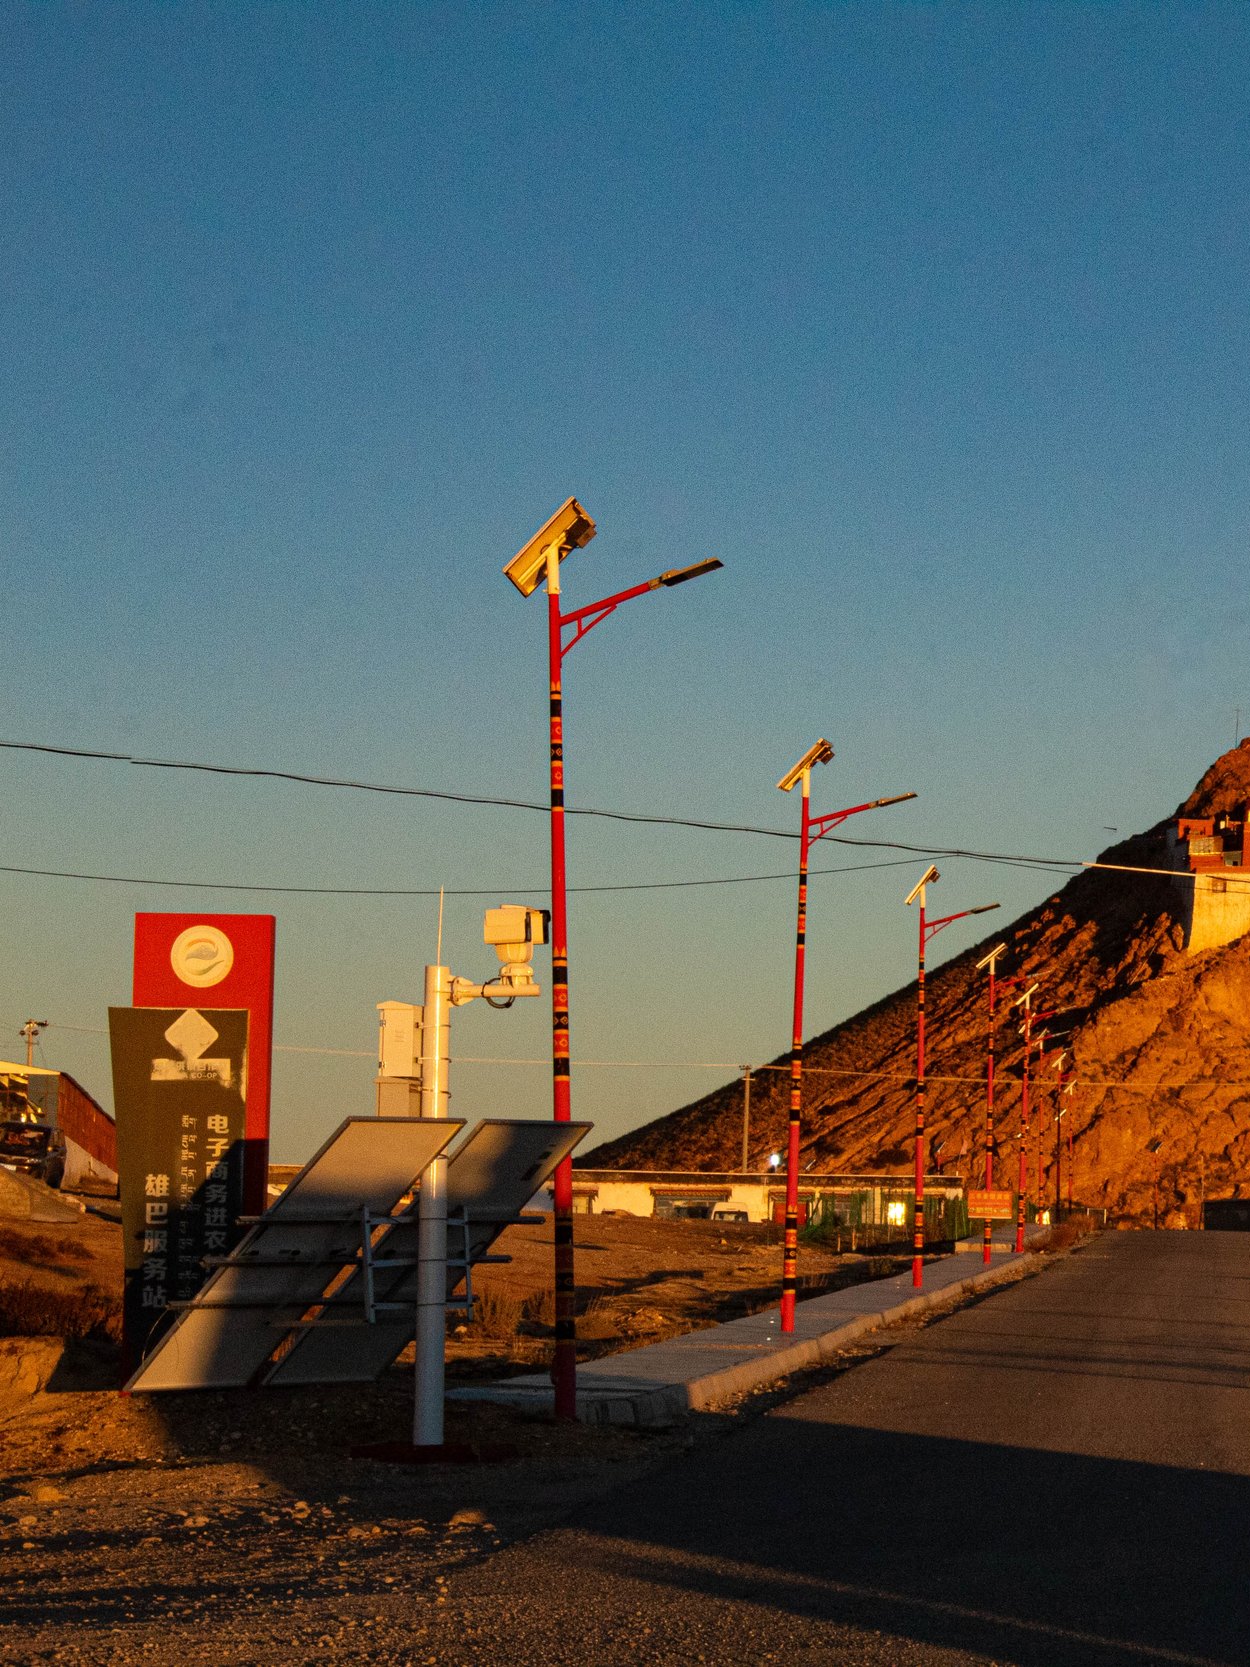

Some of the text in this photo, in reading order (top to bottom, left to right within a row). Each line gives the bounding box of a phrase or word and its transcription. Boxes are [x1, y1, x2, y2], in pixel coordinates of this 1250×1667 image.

[142, 1173, 170, 1308] 雄巴服务站
[203, 1114, 230, 1266] 电子商务进农
